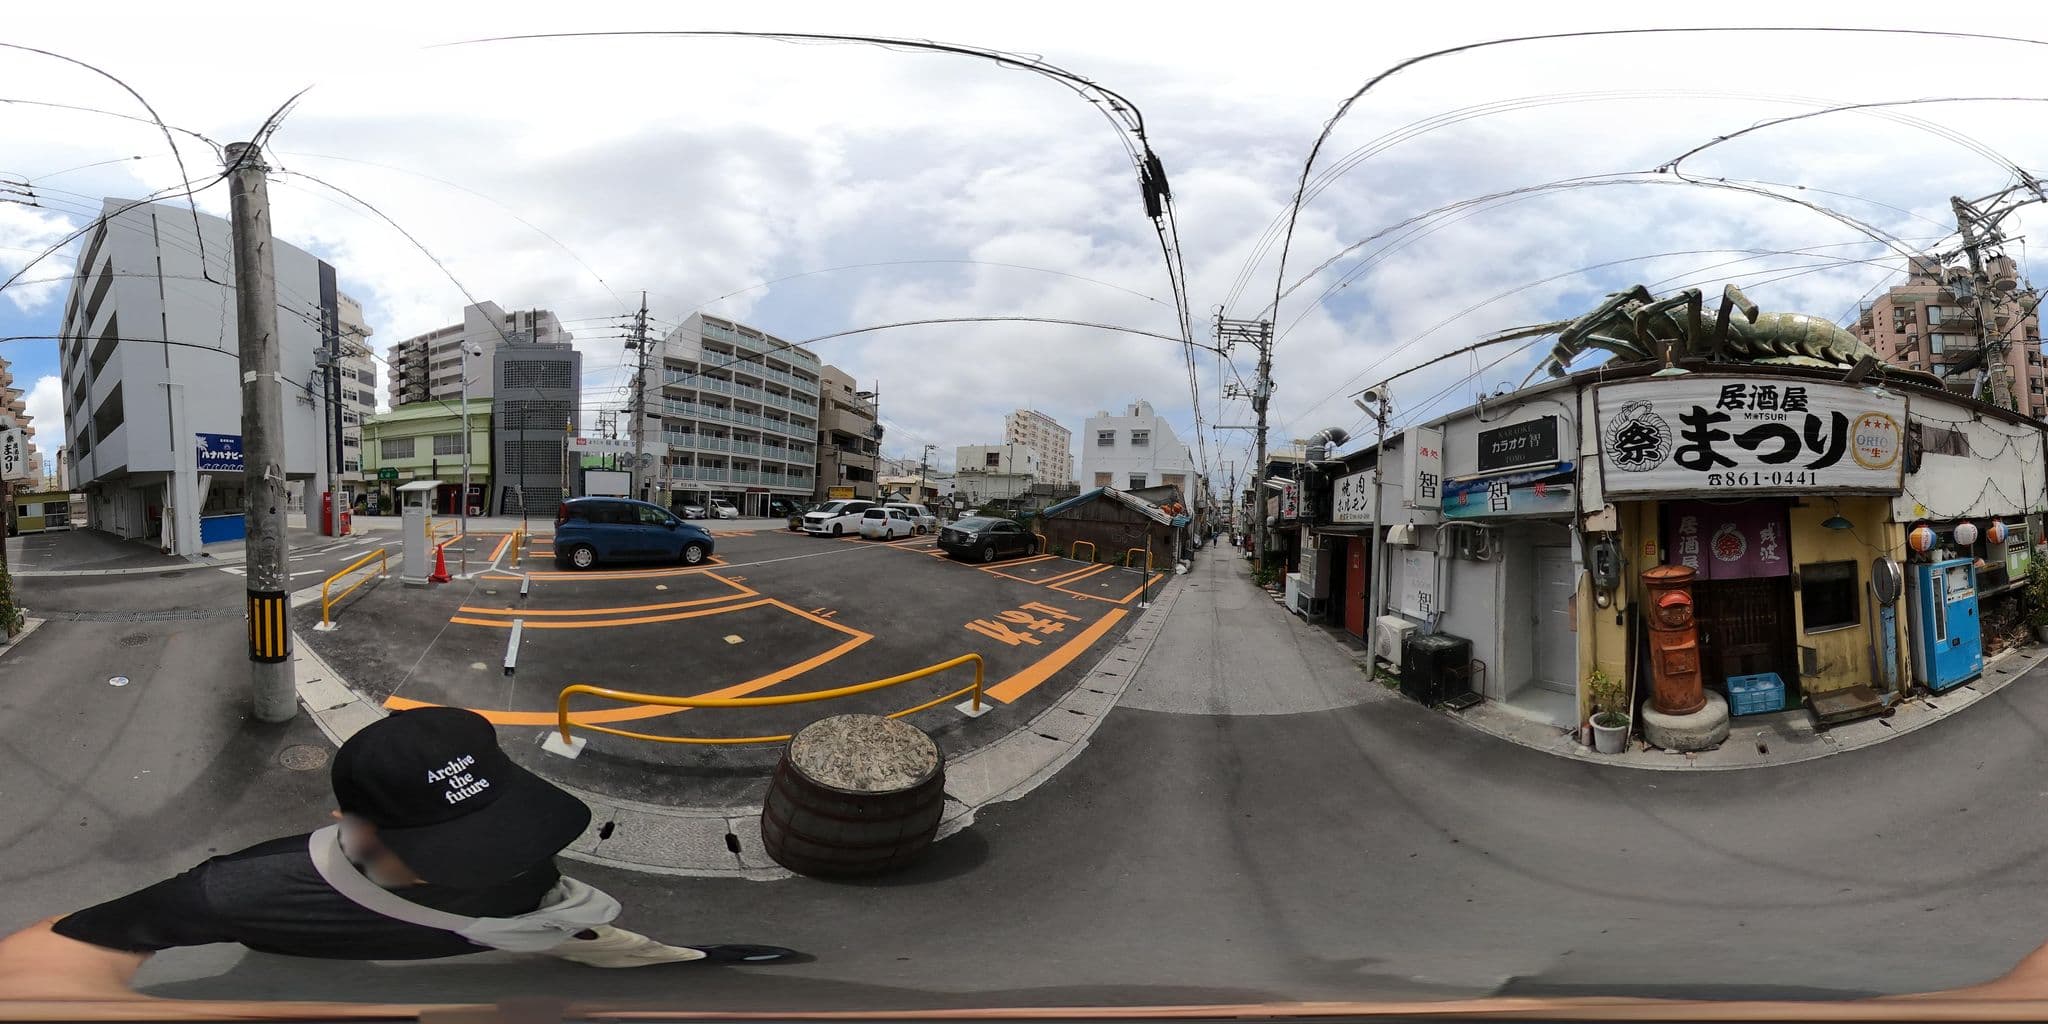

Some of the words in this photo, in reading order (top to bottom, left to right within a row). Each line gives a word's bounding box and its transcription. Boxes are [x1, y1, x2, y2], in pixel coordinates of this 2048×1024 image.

[1715, 383, 1809, 413] 居酒屋
[1491, 436, 1527, 454] カラオケ
[1616, 420, 1662, 463] 祭
[1673, 405, 1849, 471] まつり
[4, 443, 13, 473] まつり
[1417, 470, 1438, 499] 智
[1487, 480, 1511, 513] 智
[1416, 590, 1432, 613] 智
[963, 600, 1083, 647] 止まれ
[428, 754, 475, 783] Archive
[449, 773, 474, 789] the
[445, 778, 490, 804] future
